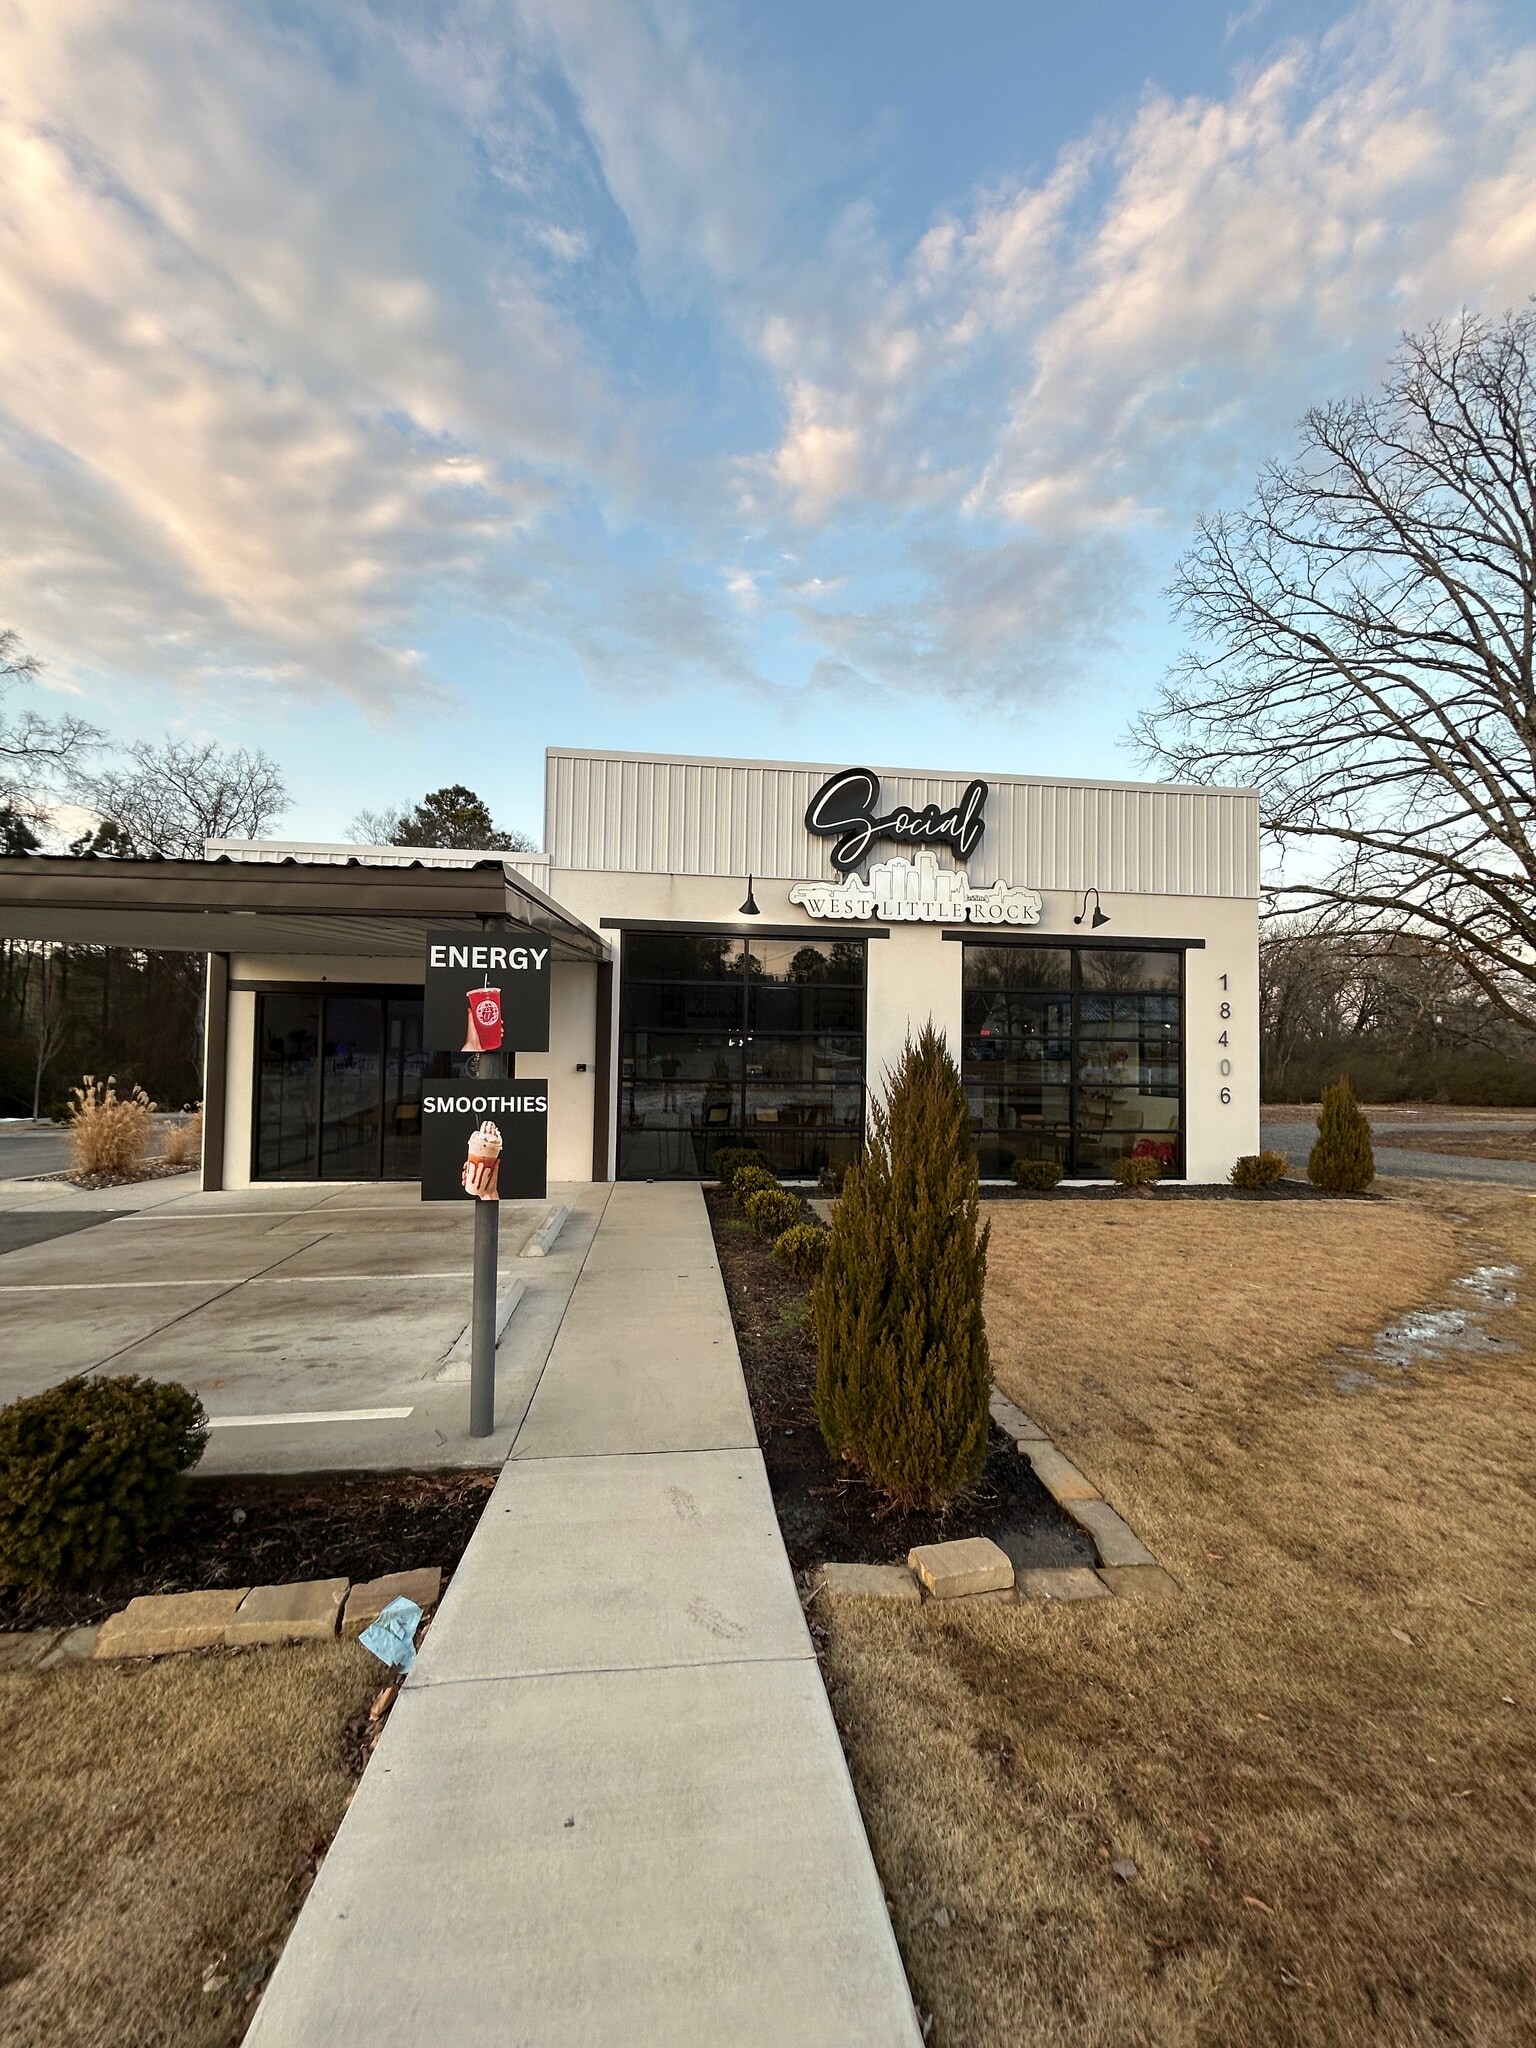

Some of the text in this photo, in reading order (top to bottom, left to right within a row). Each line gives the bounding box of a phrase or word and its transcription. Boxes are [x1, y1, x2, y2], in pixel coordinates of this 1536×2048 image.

[812, 775, 982, 864] Social
[807, 899, 1034, 919] WEST LITTLE ROCK
[430, 945, 548, 970] ENERGY
[1218, 973, 1231, 1104] 18406
[423, 1096, 547, 1113] SMOOTHIES
